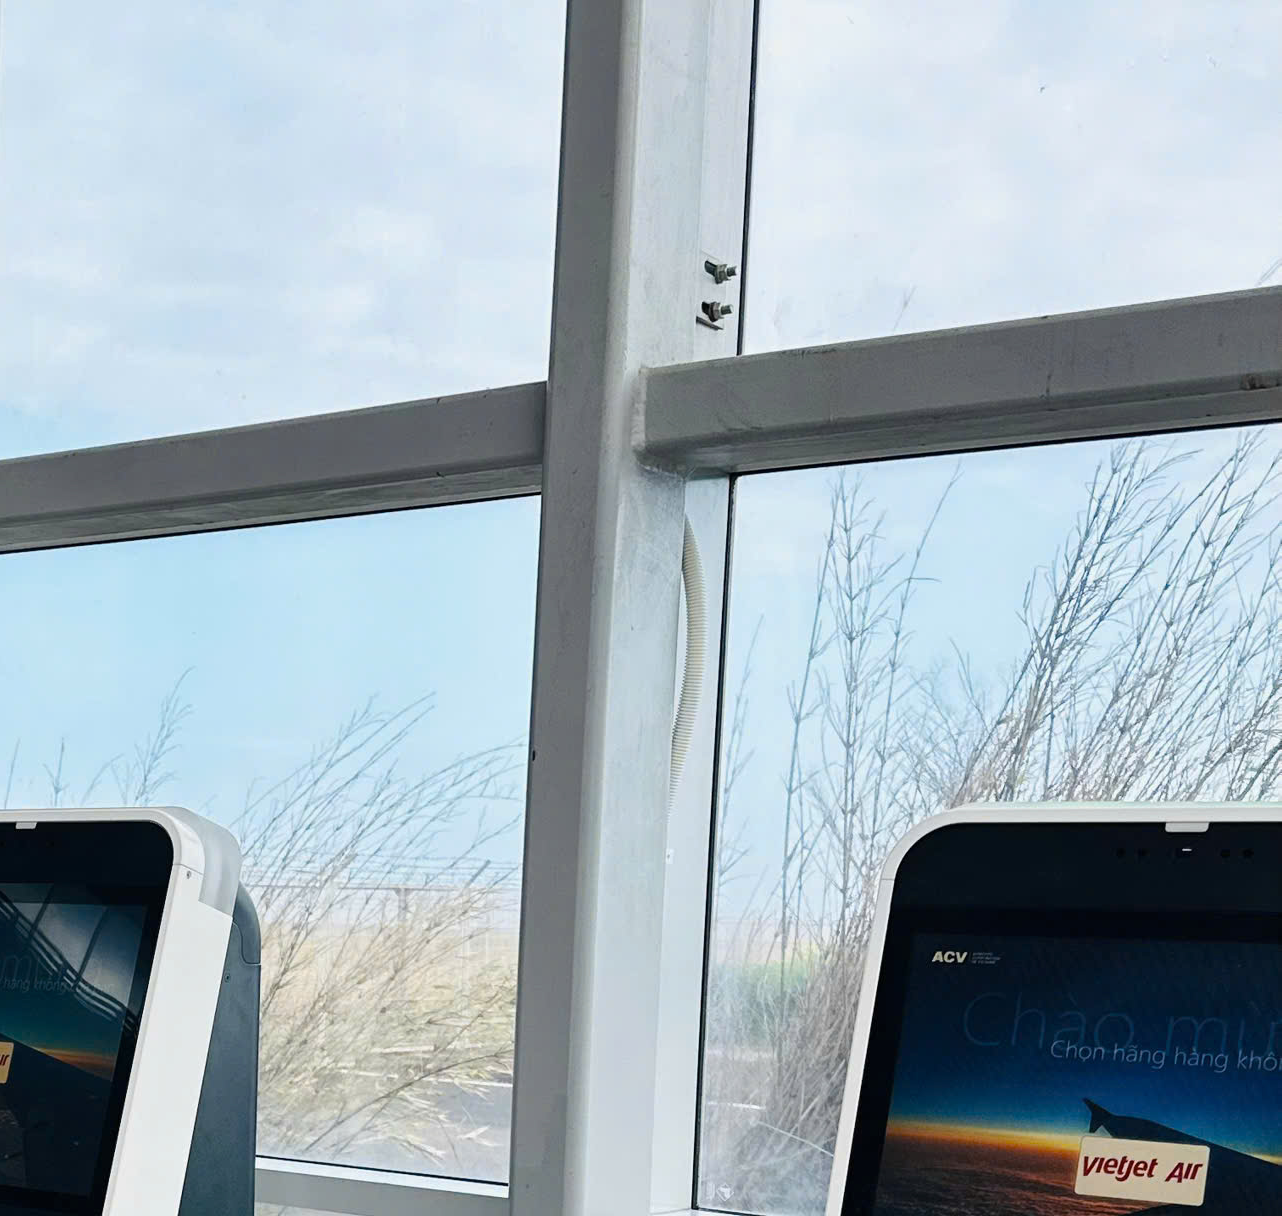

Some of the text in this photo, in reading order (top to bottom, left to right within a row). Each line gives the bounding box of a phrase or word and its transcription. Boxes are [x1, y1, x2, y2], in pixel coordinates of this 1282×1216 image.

[931, 951, 968, 963] ACV
[1050, 1040, 1282, 1074] Chọn hãng hàng khô
